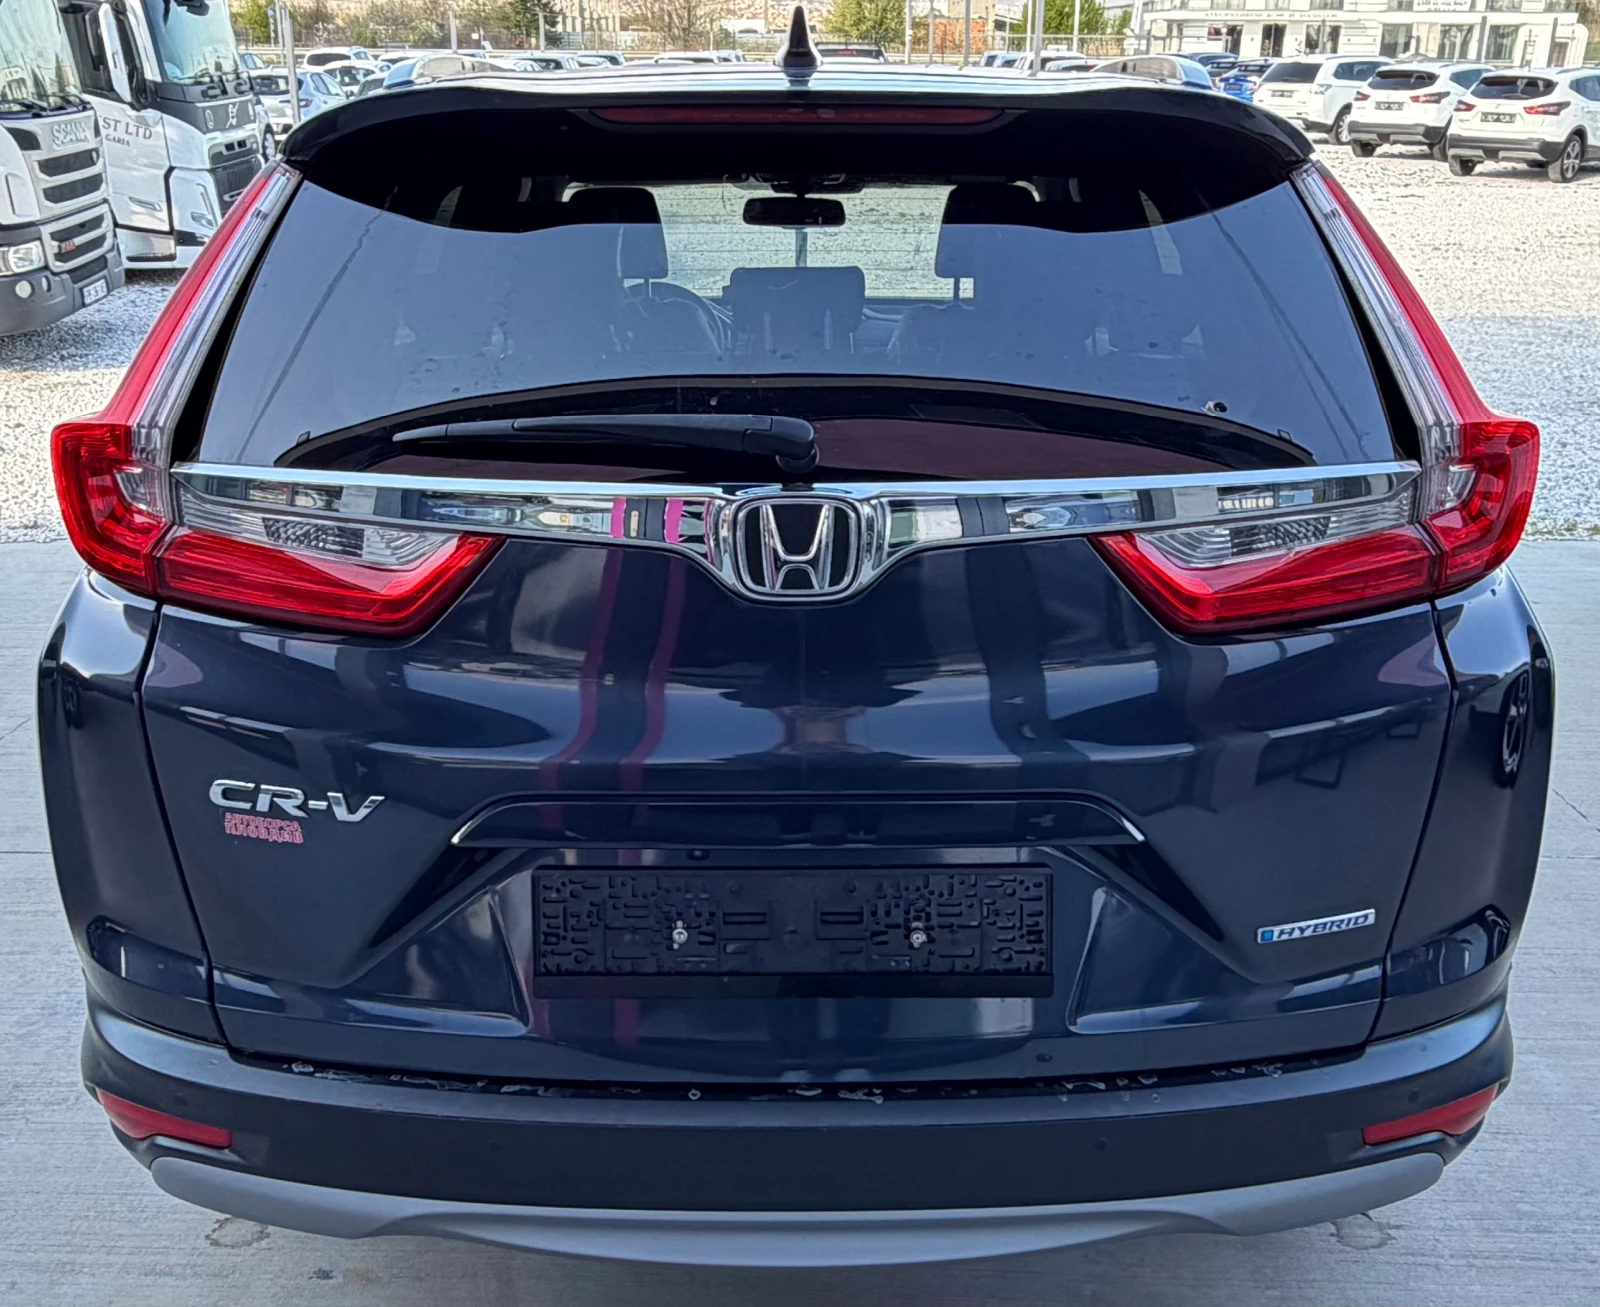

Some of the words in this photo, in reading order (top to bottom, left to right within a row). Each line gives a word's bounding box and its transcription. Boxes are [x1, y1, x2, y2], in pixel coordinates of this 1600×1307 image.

[53, 121, 89, 147] SCANIA
[99, 115, 121, 132] ST
[125, 122, 153, 140] LTD
[209, 779, 385, 822] CR-V
[1278, 914, 1369, 939] HYBRID
